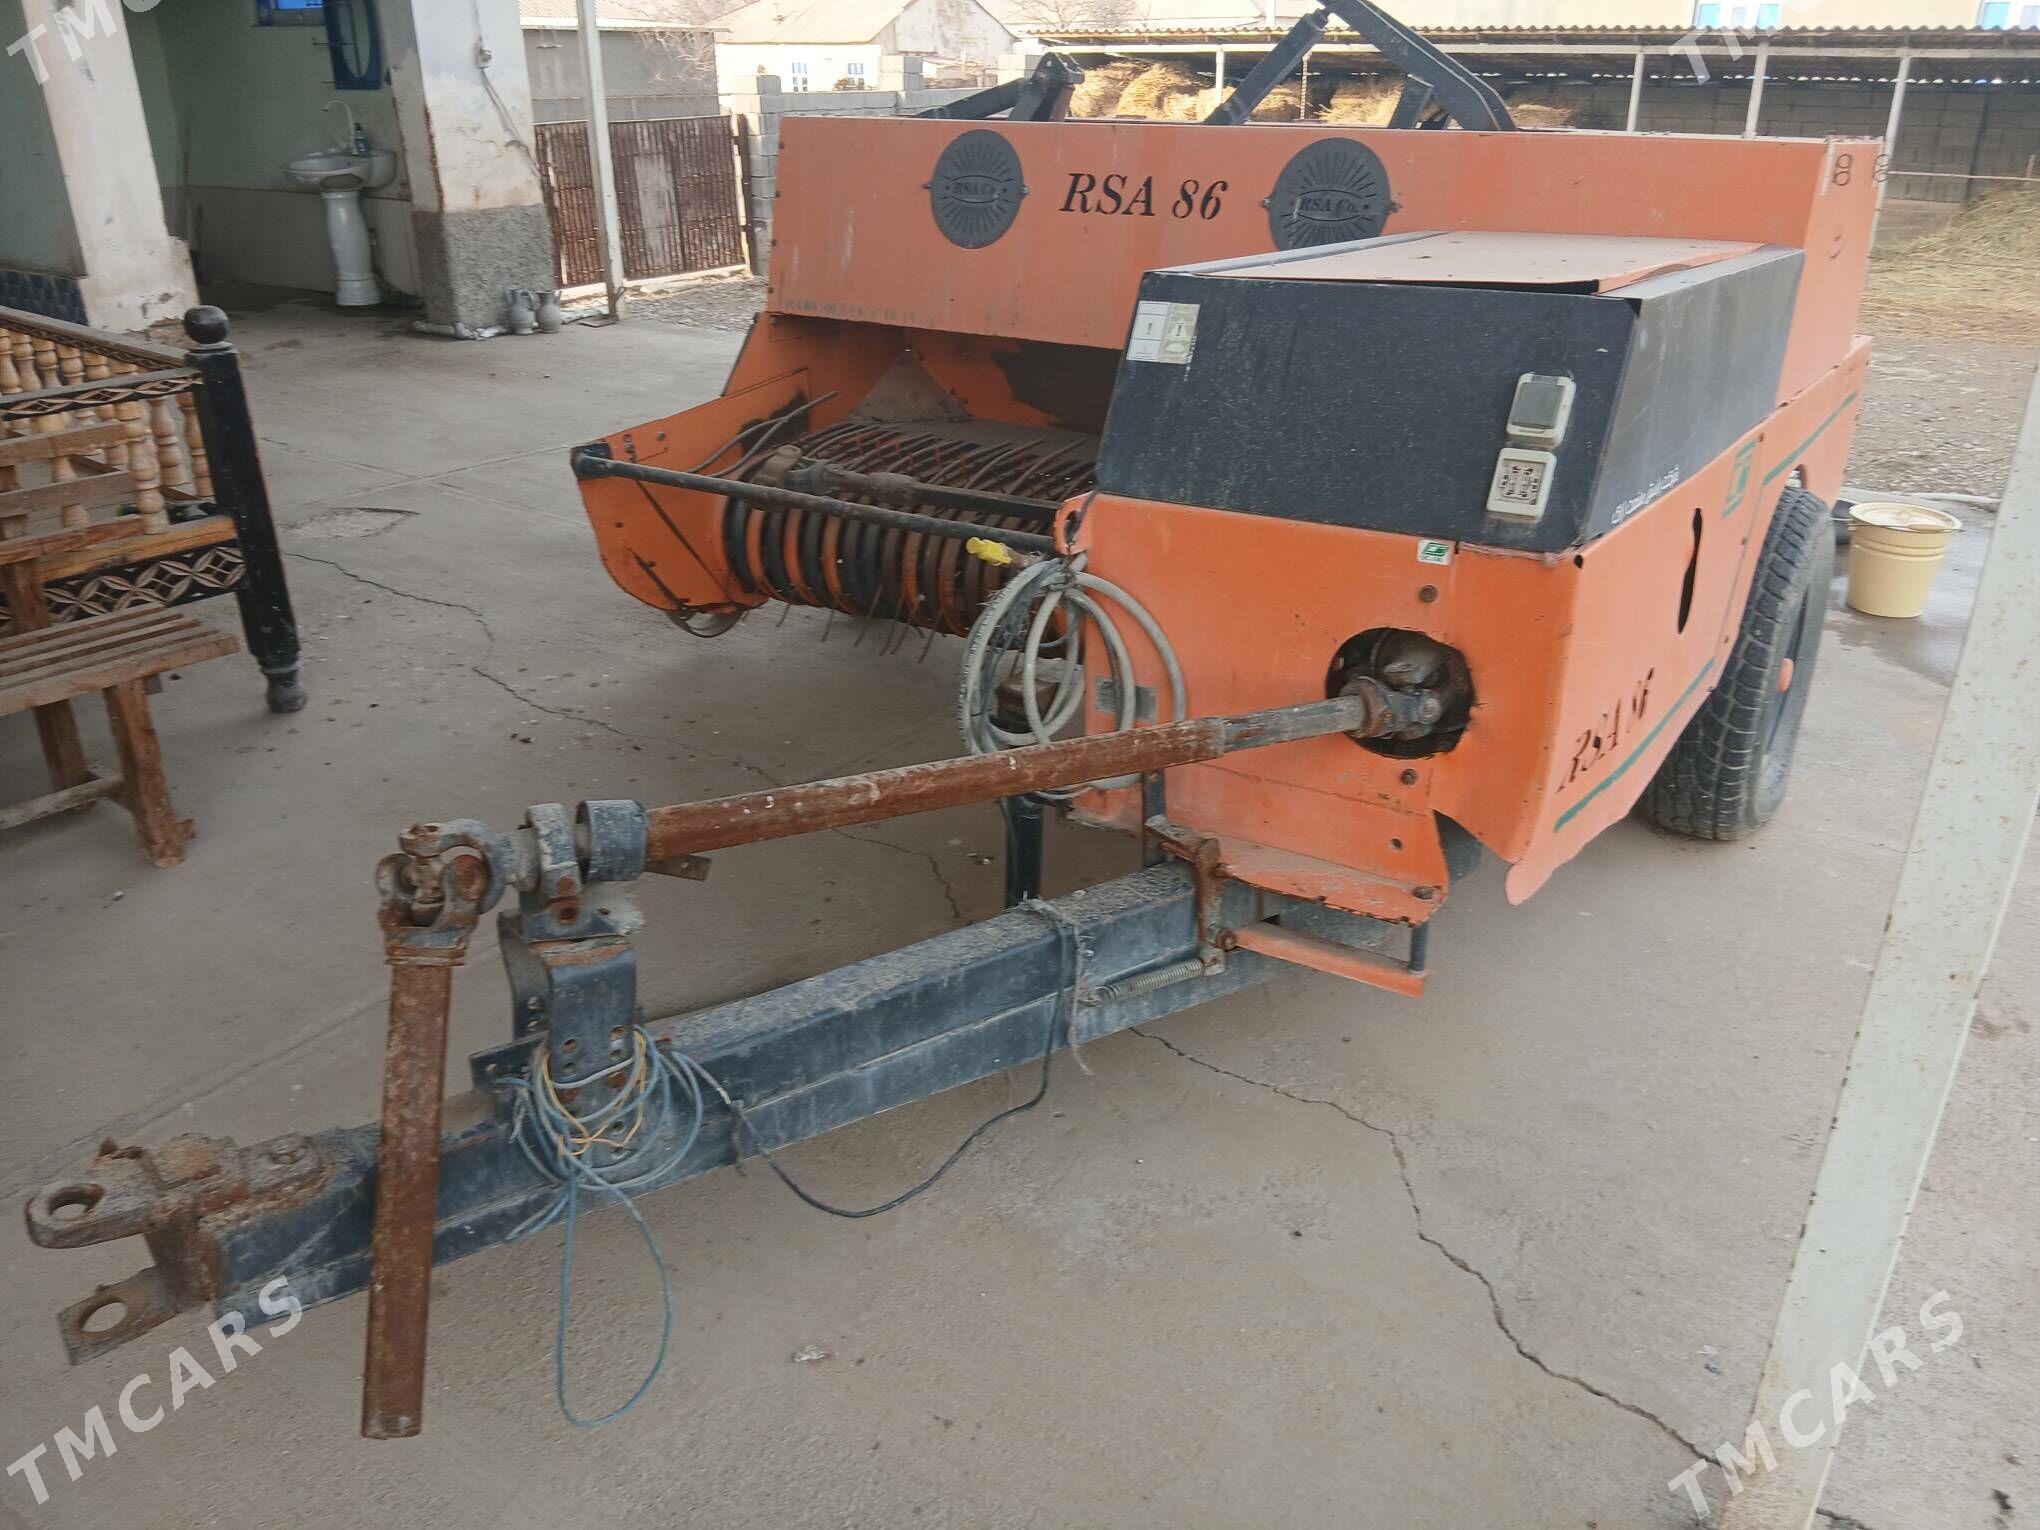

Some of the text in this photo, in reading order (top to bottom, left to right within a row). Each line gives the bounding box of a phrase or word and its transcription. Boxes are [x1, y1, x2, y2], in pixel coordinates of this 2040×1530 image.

[1058, 172, 1228, 220] RSA 86
[1555, 698, 1621, 794] RSA
